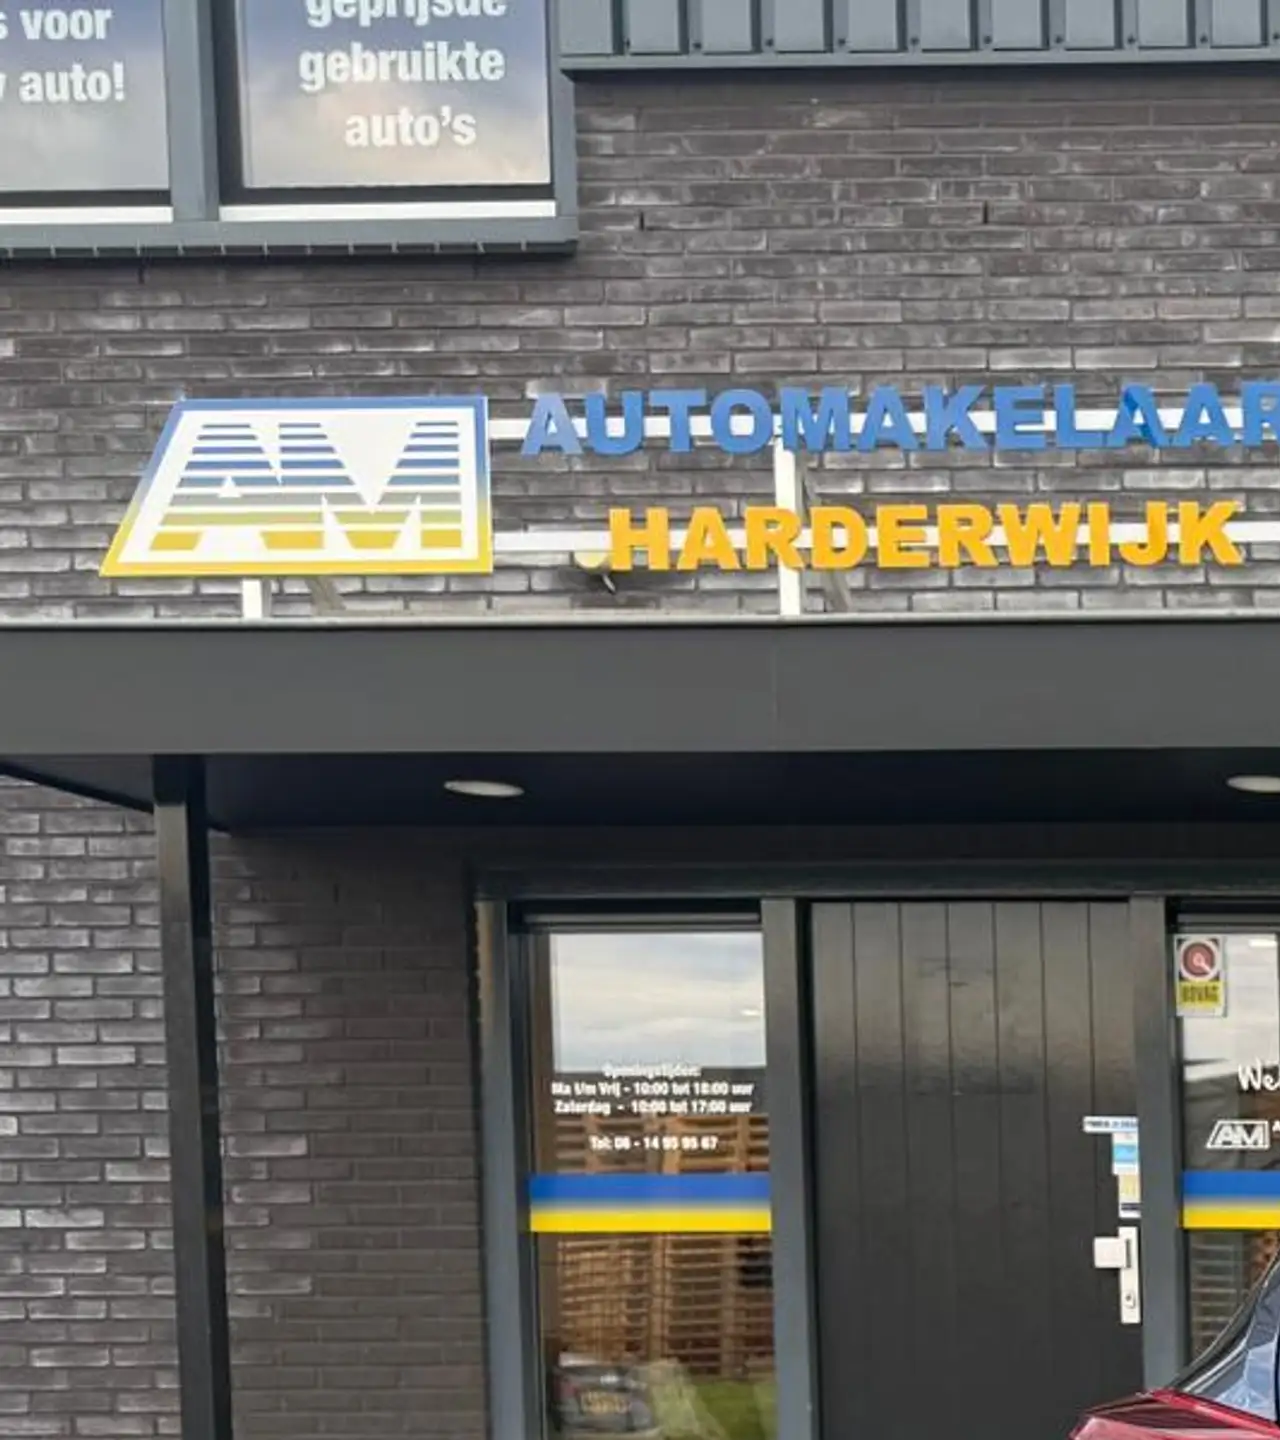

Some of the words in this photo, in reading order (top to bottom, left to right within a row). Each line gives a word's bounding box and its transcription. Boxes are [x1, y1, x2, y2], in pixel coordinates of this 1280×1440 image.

[19, 9, 113, 40] voor
[19, 61, 125, 102] auto!
[299, 41, 506, 91] gebruikte
[345, 106, 478, 147] auto's
[608, 501, 1246, 572] HARDERWIJK
